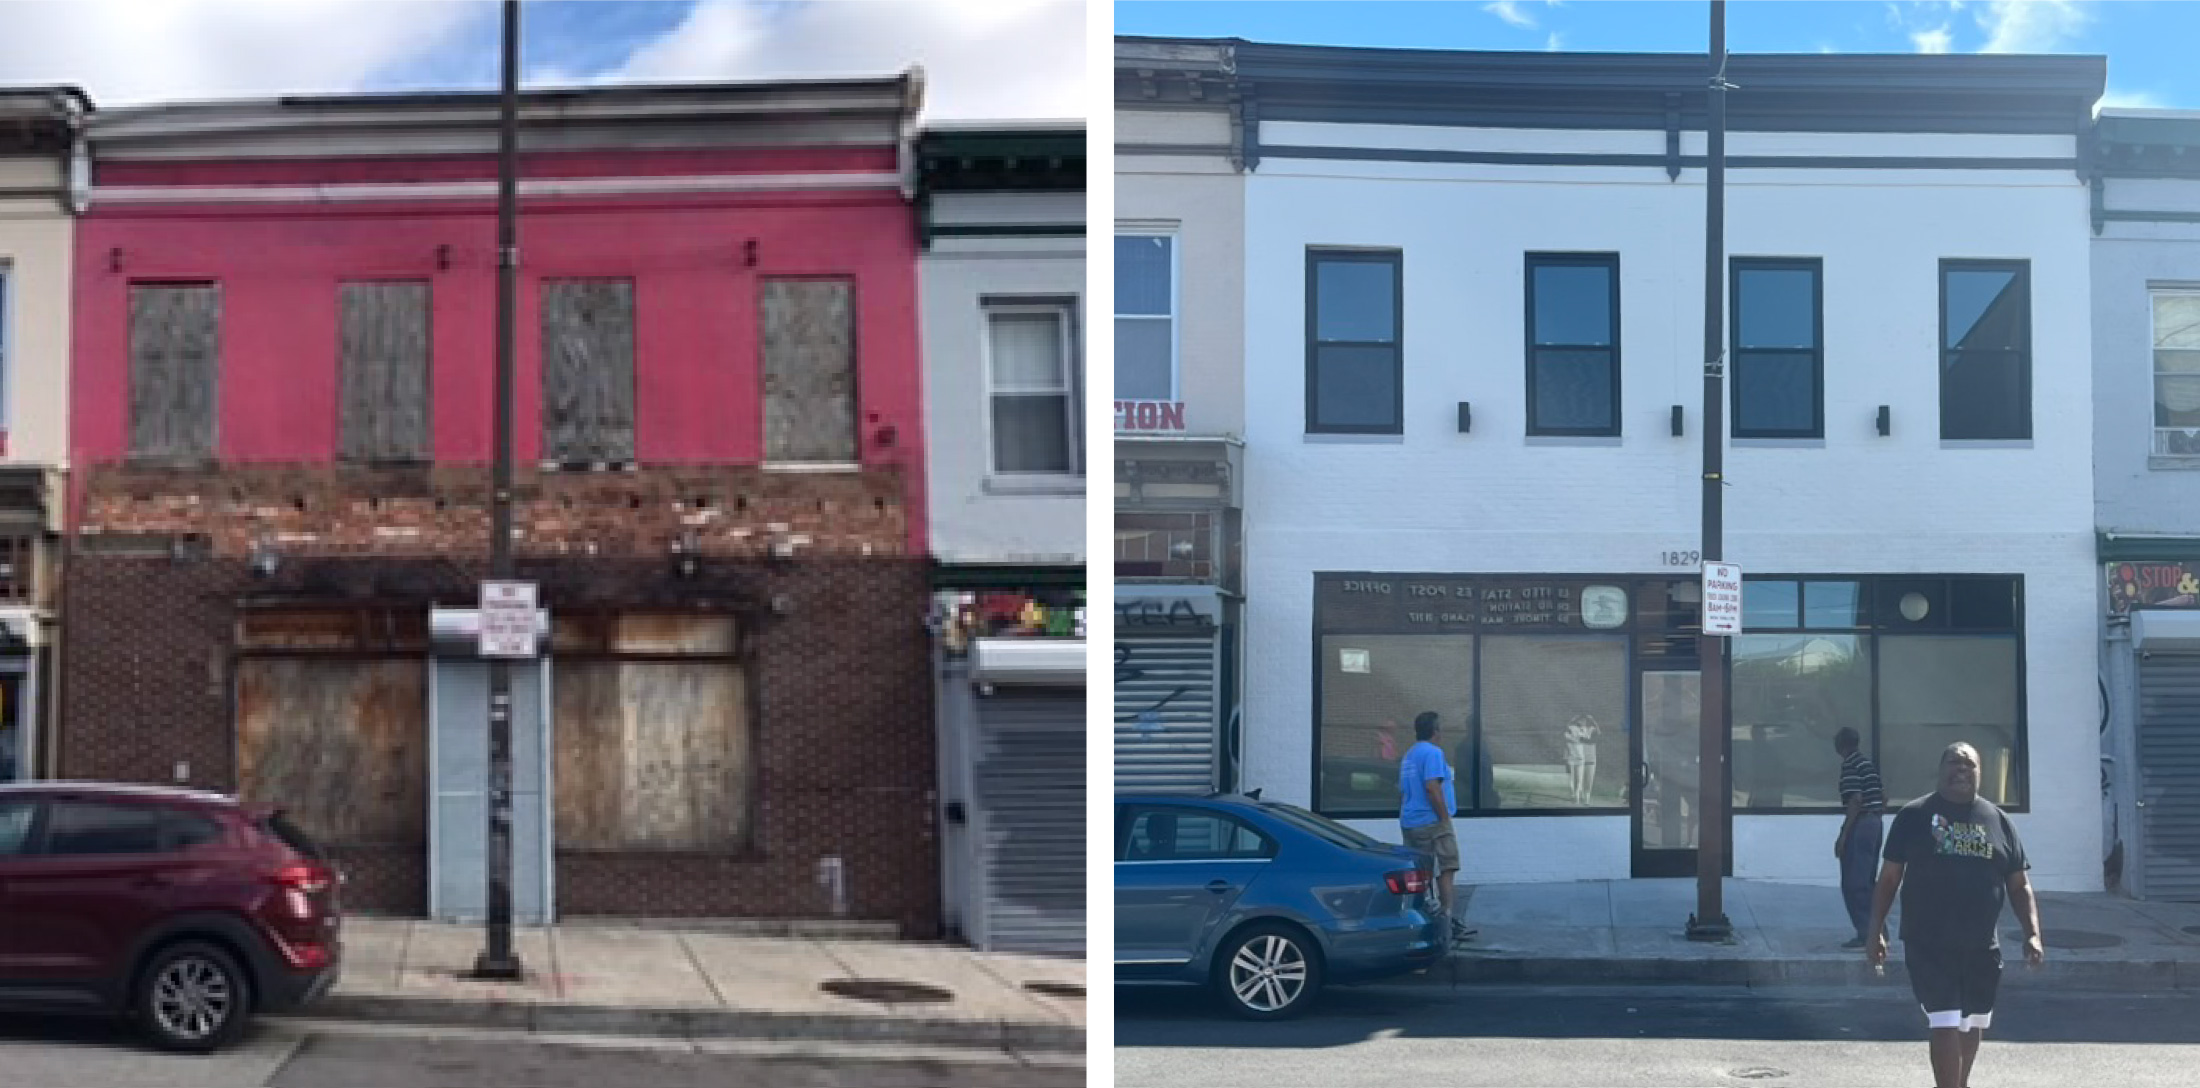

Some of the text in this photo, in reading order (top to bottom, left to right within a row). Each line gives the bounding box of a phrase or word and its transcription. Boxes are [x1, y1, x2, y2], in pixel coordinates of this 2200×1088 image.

[1661, 550, 1700, 567] 1829
[1717, 567, 1728, 578] NO
[2141, 566, 2181, 588] STOP
[1707, 579, 1738, 591] PARKING
